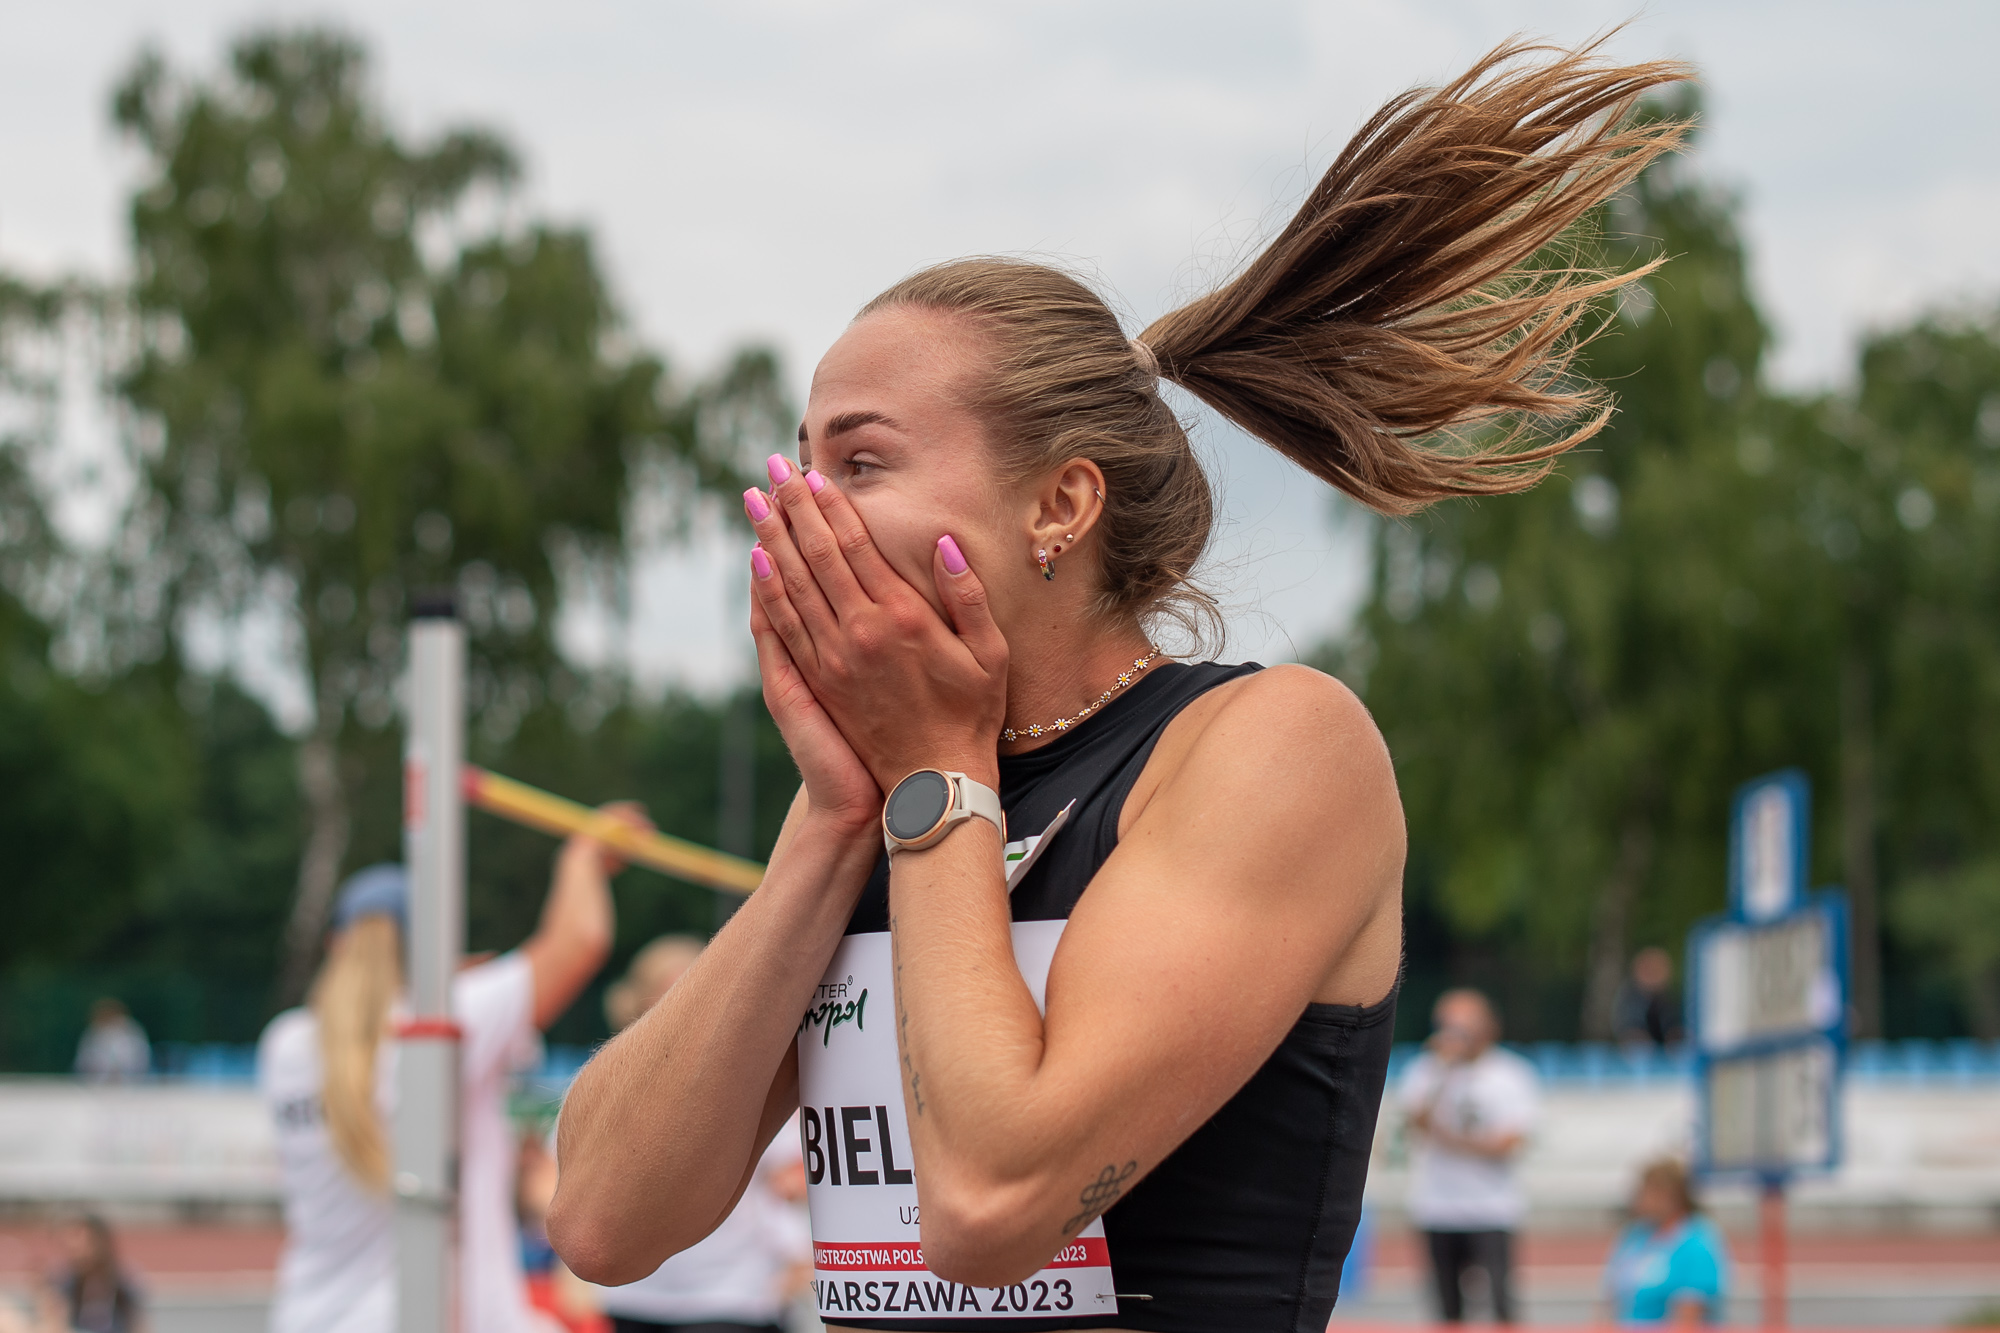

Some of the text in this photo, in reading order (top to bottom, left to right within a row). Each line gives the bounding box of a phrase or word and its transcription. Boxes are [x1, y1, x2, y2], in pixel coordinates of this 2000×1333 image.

[804, 1105, 916, 1186] BIEL
[893, 1249, 926, 1265] POLS
[989, 1279, 1074, 1312] 2023
